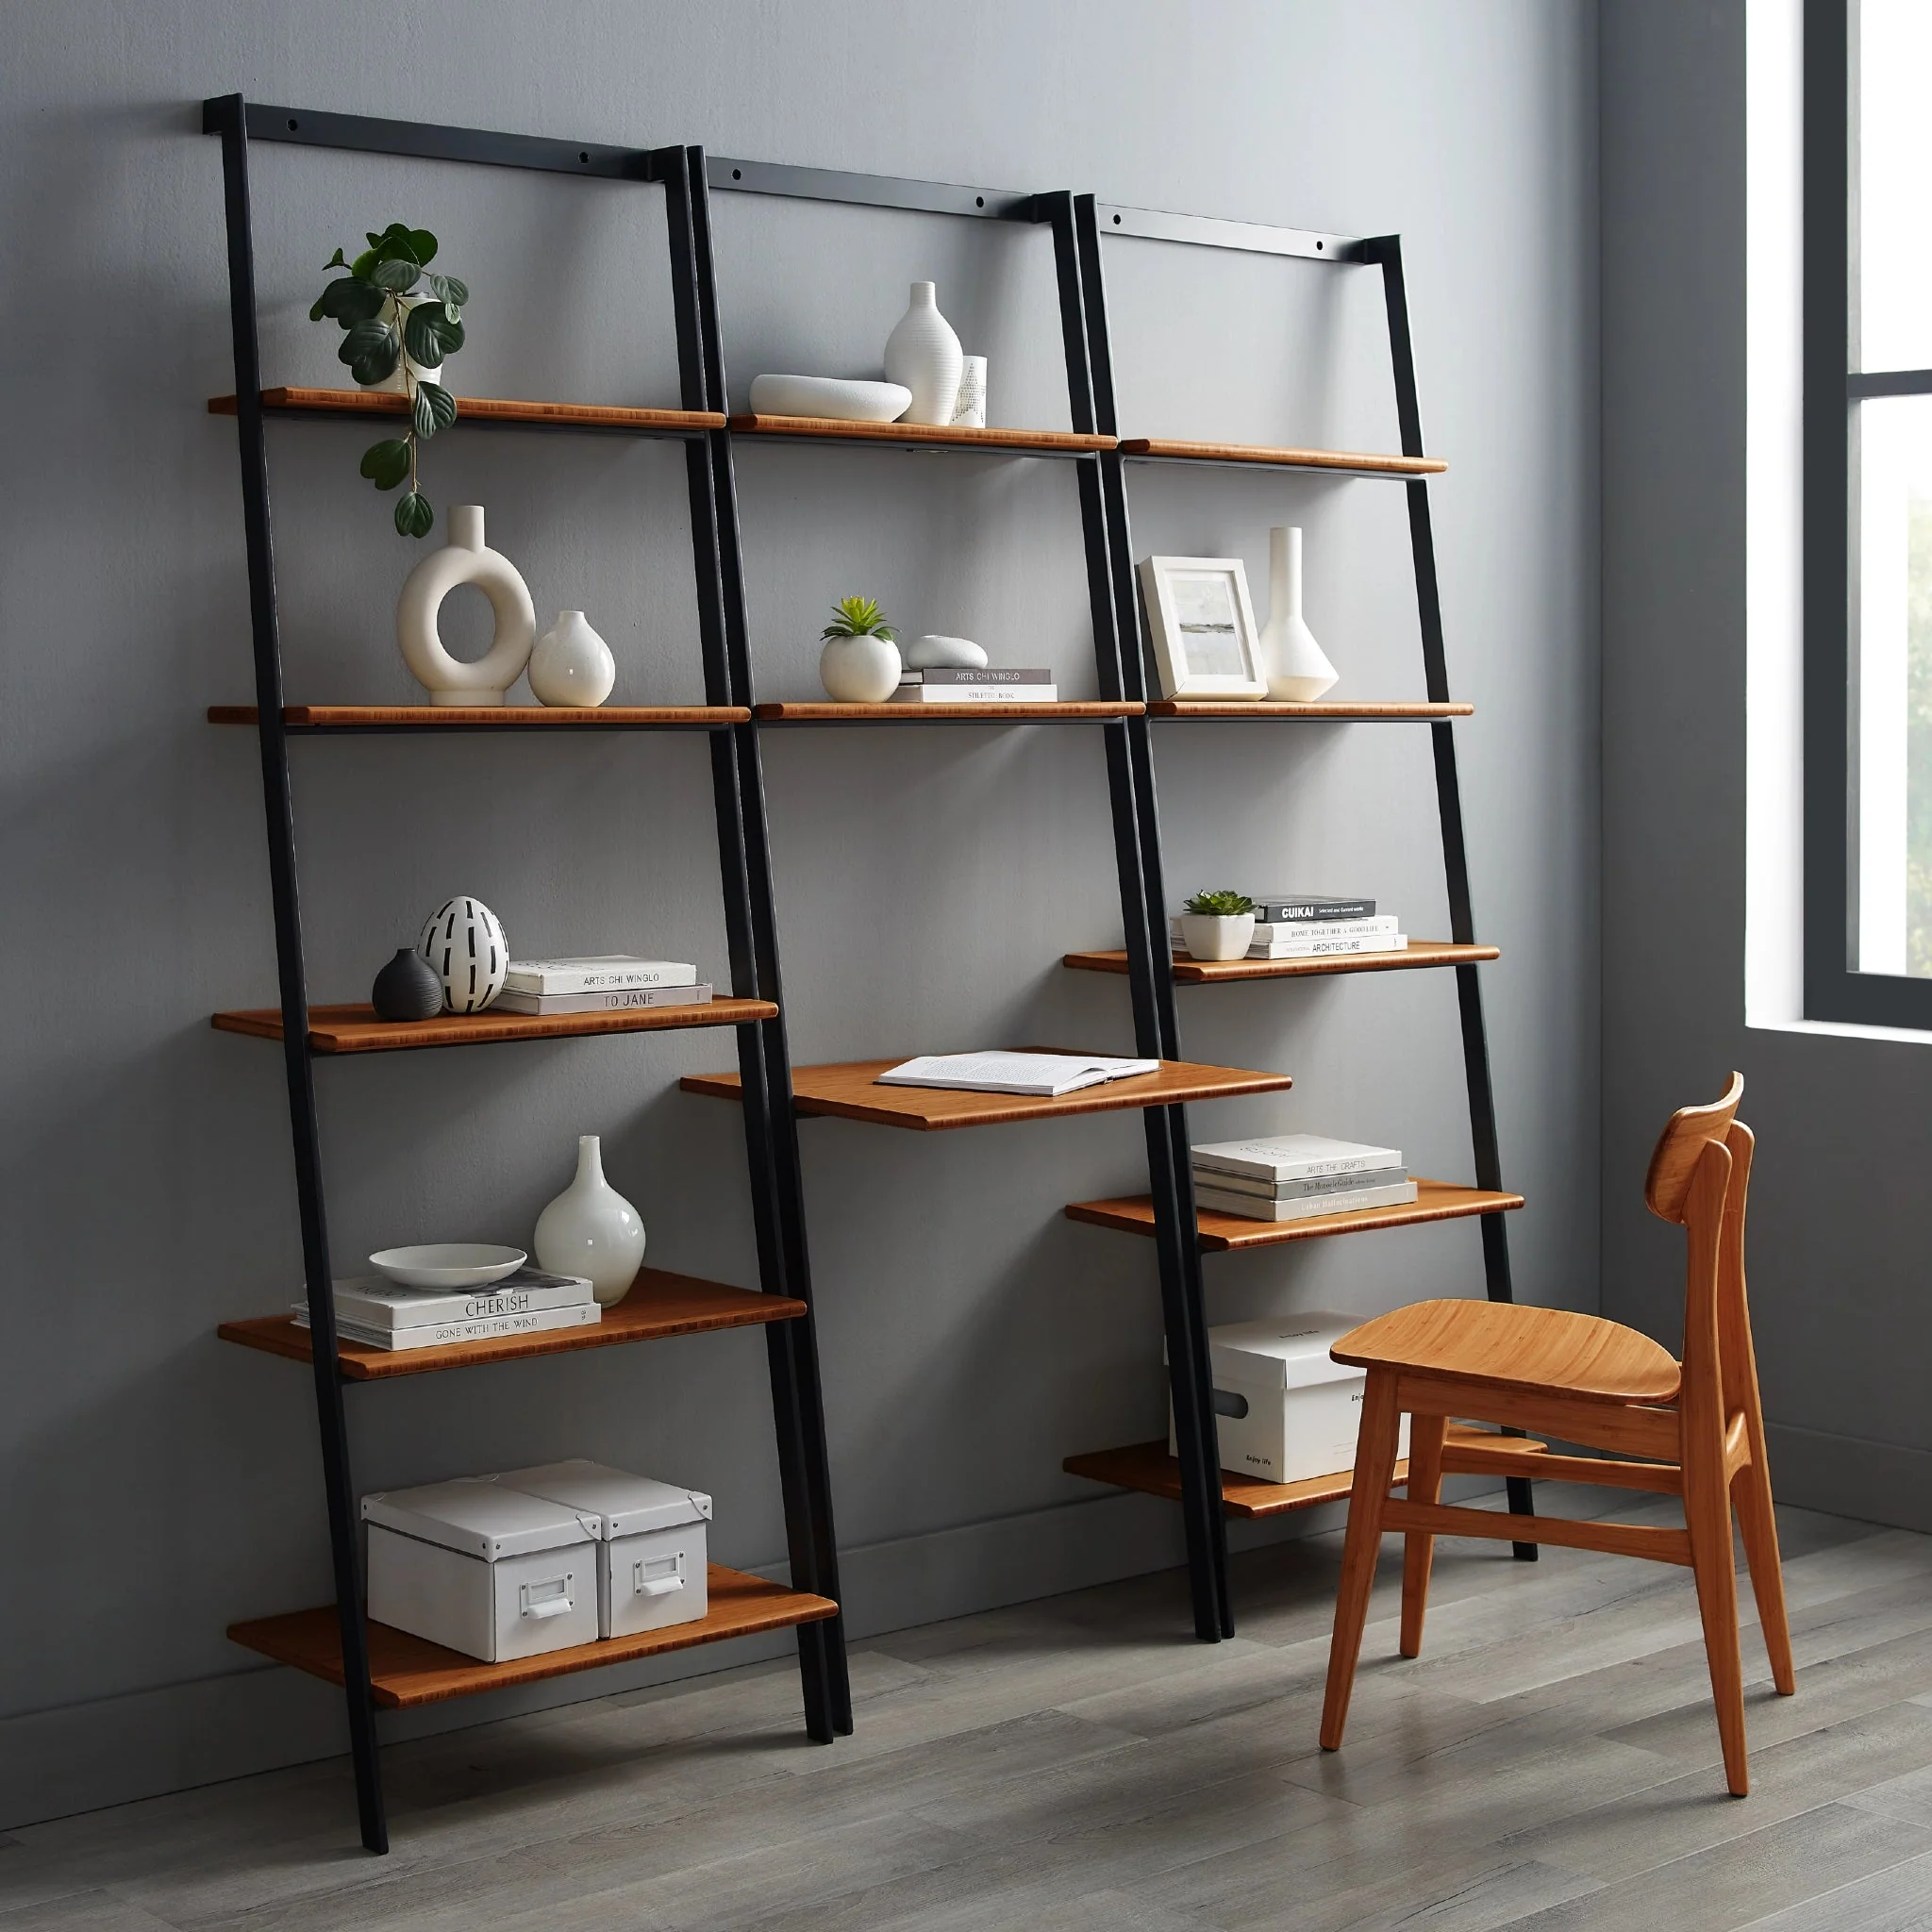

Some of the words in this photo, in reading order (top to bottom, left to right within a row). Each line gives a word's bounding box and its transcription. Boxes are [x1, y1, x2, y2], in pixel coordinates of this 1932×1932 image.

[956, 672, 974, 680] ARTS
[1281, 907, 1314, 919] CUIKAI
[1311, 926, 1341, 937] TOGETHER
[1312, 941, 1360, 953] ARCHITECTURE
[583, 976, 605, 986] ARTS
[608, 975, 623, 984] CHI
[625, 973, 659, 984] WINGLO
[604, 995, 619, 1008] TO
[623, 992, 655, 1007] JANE
[1307, 1164, 1324, 1174] ARTS
[1341, 1159, 1366, 1171] CRAFTS
[465, 1293, 528, 1317] CHERISH
[435, 1327, 461, 1340] GONE
[465, 1324, 489, 1335] WITH
[492, 1321, 510, 1332] THE
[513, 1317, 538, 1328] WIND
